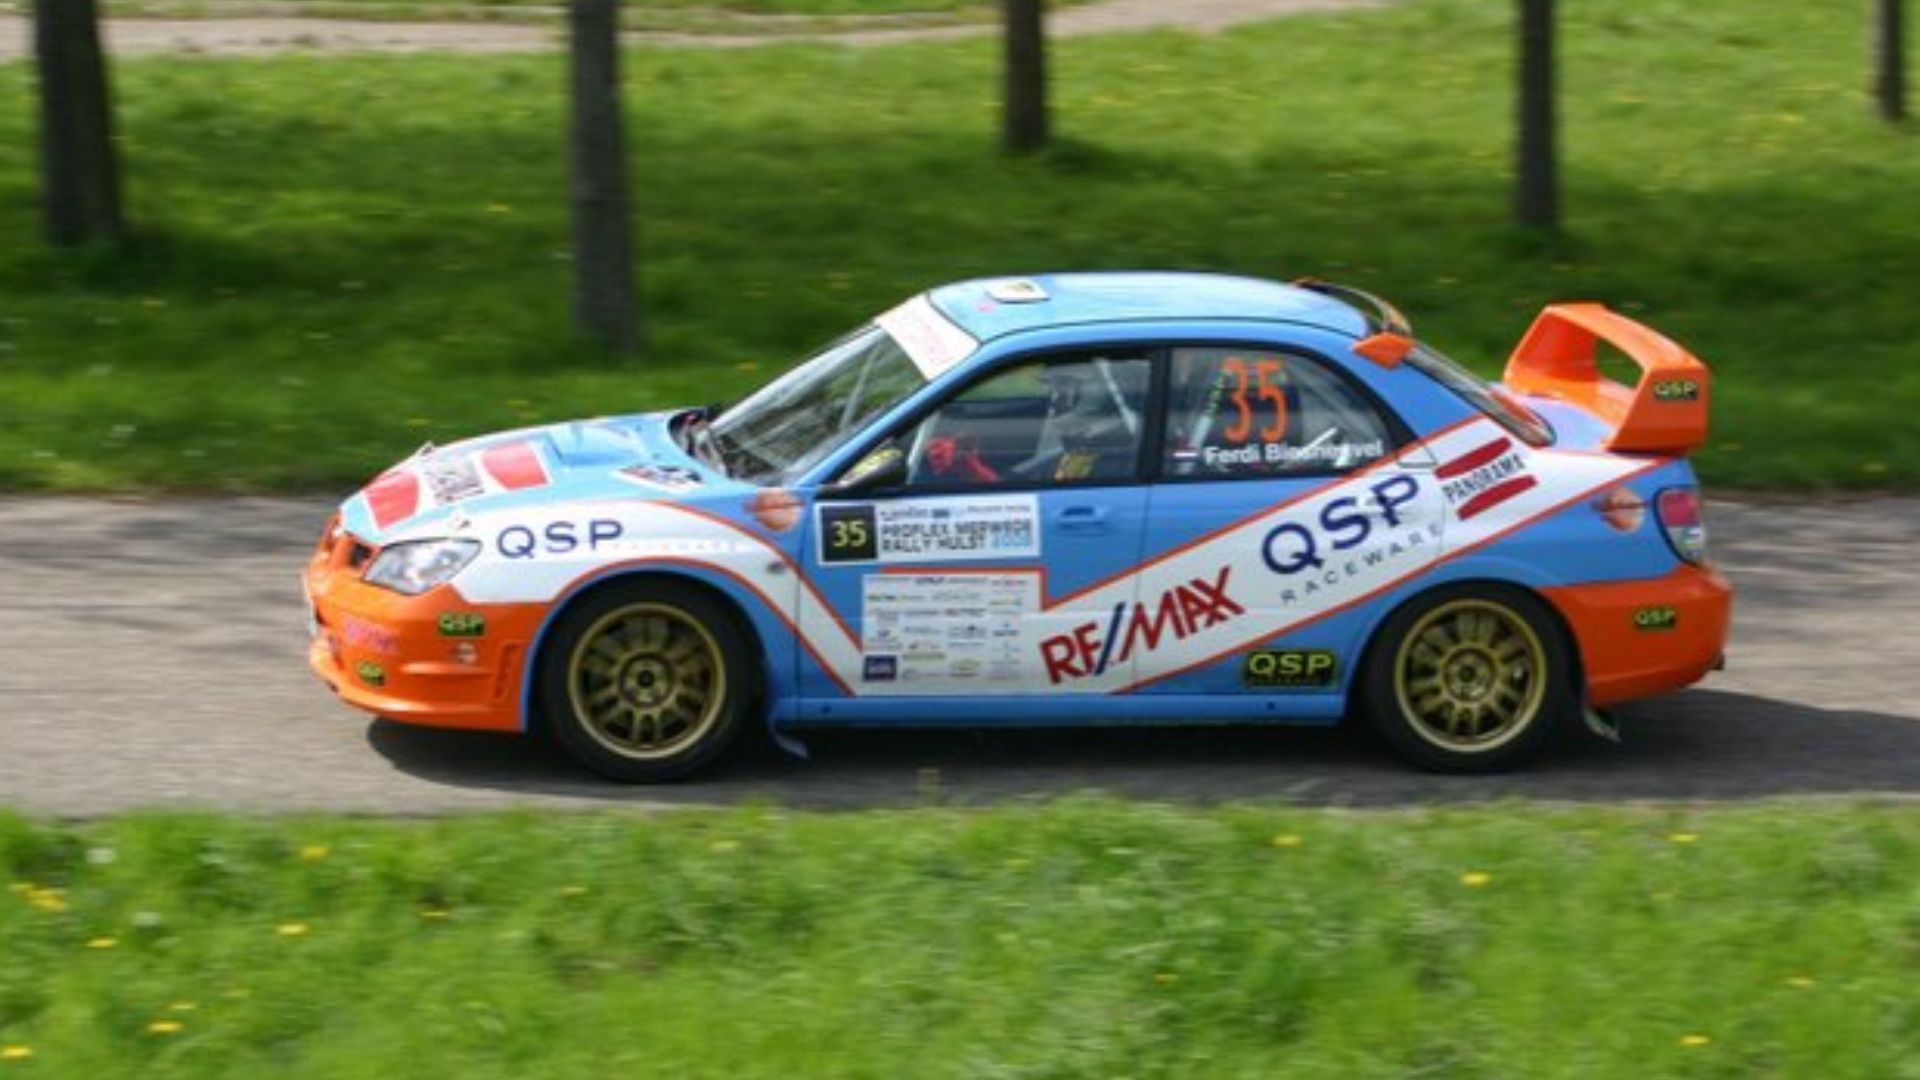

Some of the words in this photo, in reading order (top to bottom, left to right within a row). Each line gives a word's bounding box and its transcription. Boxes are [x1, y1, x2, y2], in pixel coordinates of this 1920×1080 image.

[1223, 356, 1287, 443] 35
[1653, 381, 1698, 396] QSP
[1206, 443, 1260, 464] Ferdi
[1442, 453, 1526, 503] PANORAMA
[832, 520, 867, 547] 35
[1262, 474, 1419, 575] QSP
[496, 518, 625, 559] QSP
[881, 535, 931, 552] RALLY
[938, 535, 986, 550] HULST
[1280, 522, 1442, 603] RACEWARE
[440, 612, 485, 632] QSP
[1039, 564, 1246, 684] RE/MAX
[1635, 609, 1676, 625] QSP
[1249, 653, 1332, 676] QSP
